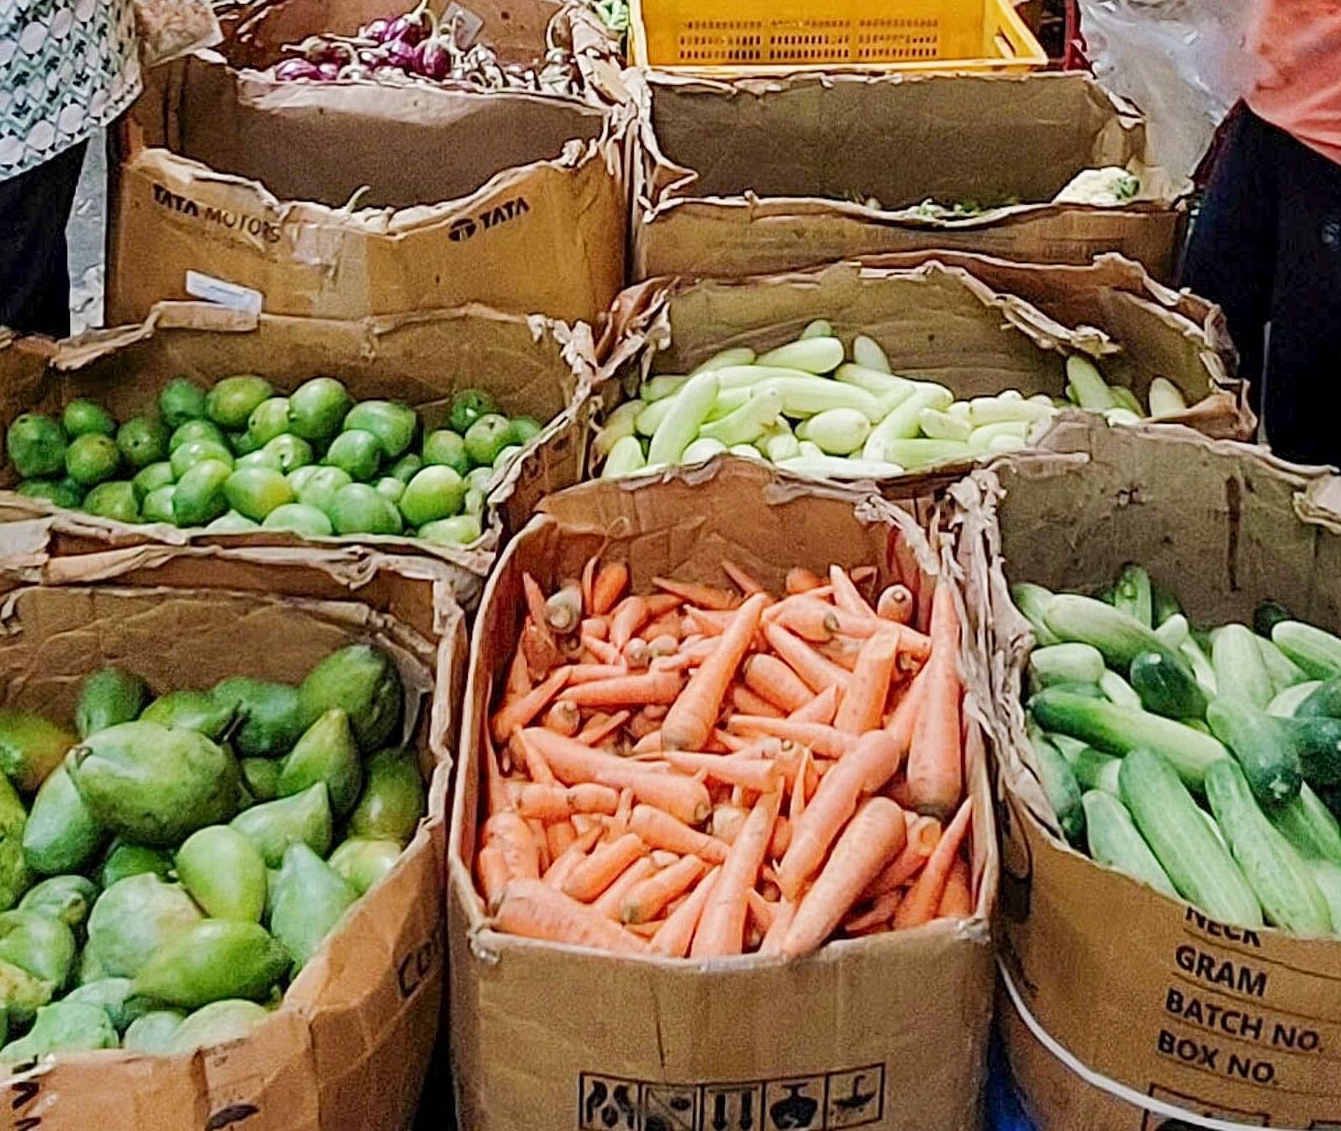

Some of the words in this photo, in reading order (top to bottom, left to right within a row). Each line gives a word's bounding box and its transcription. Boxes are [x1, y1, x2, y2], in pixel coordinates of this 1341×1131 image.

[153, 182, 199, 217] TATA
[204, 207, 281, 243] MOTORS
[478, 195, 530, 229] TATA
[1175, 945, 1267, 997] GRAM
[1166, 987, 1262, 1040] BATCH
[1272, 1024, 1325, 1053] NO.
[1159, 1029, 1218, 1069] BOX
[1227, 1055, 1279, 1085] NO.
